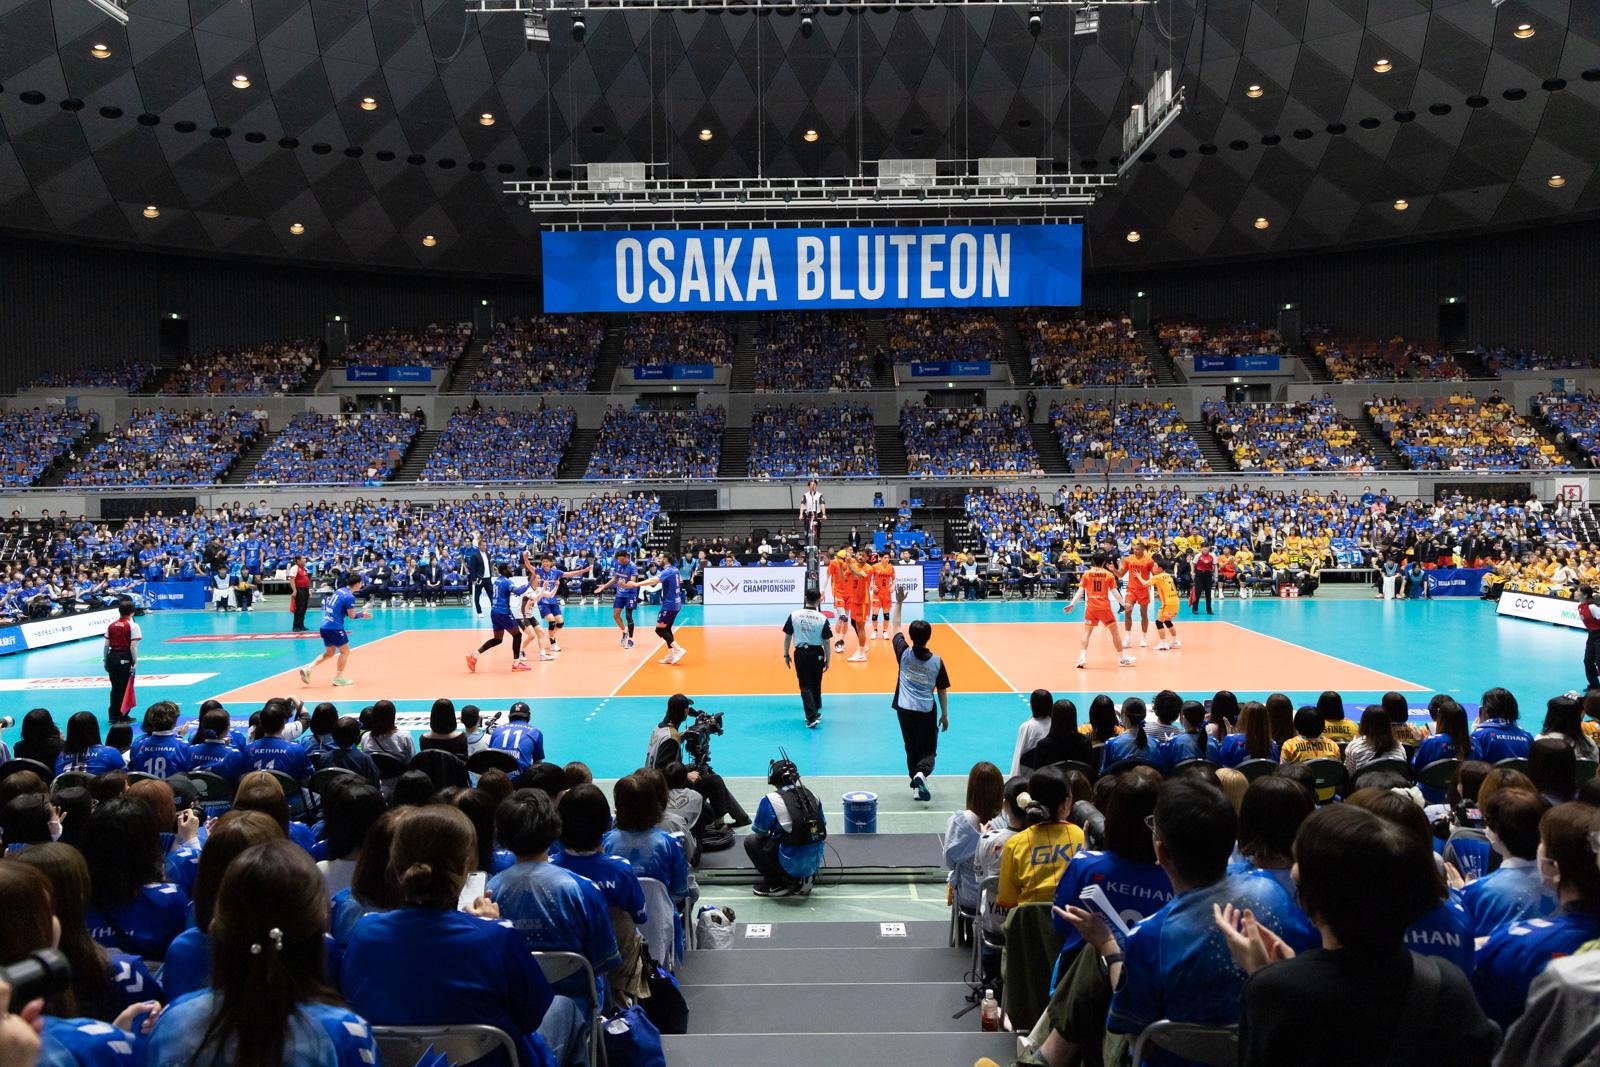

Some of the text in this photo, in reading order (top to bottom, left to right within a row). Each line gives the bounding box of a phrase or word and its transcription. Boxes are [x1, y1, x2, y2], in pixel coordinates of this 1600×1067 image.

[615, 232, 1011, 304] OSAKA BLUTEON
[743, 584, 796, 593] CHAMPIONSHIP
[1093, 580, 1102, 592] 10
[1515, 598, 1535, 610] CCC
[502, 728, 522, 749] 11
[1496, 734, 1527, 742] KEIHAN
[143, 756, 167, 780] 18
[1106, 880, 1176, 902] KEIHAN
